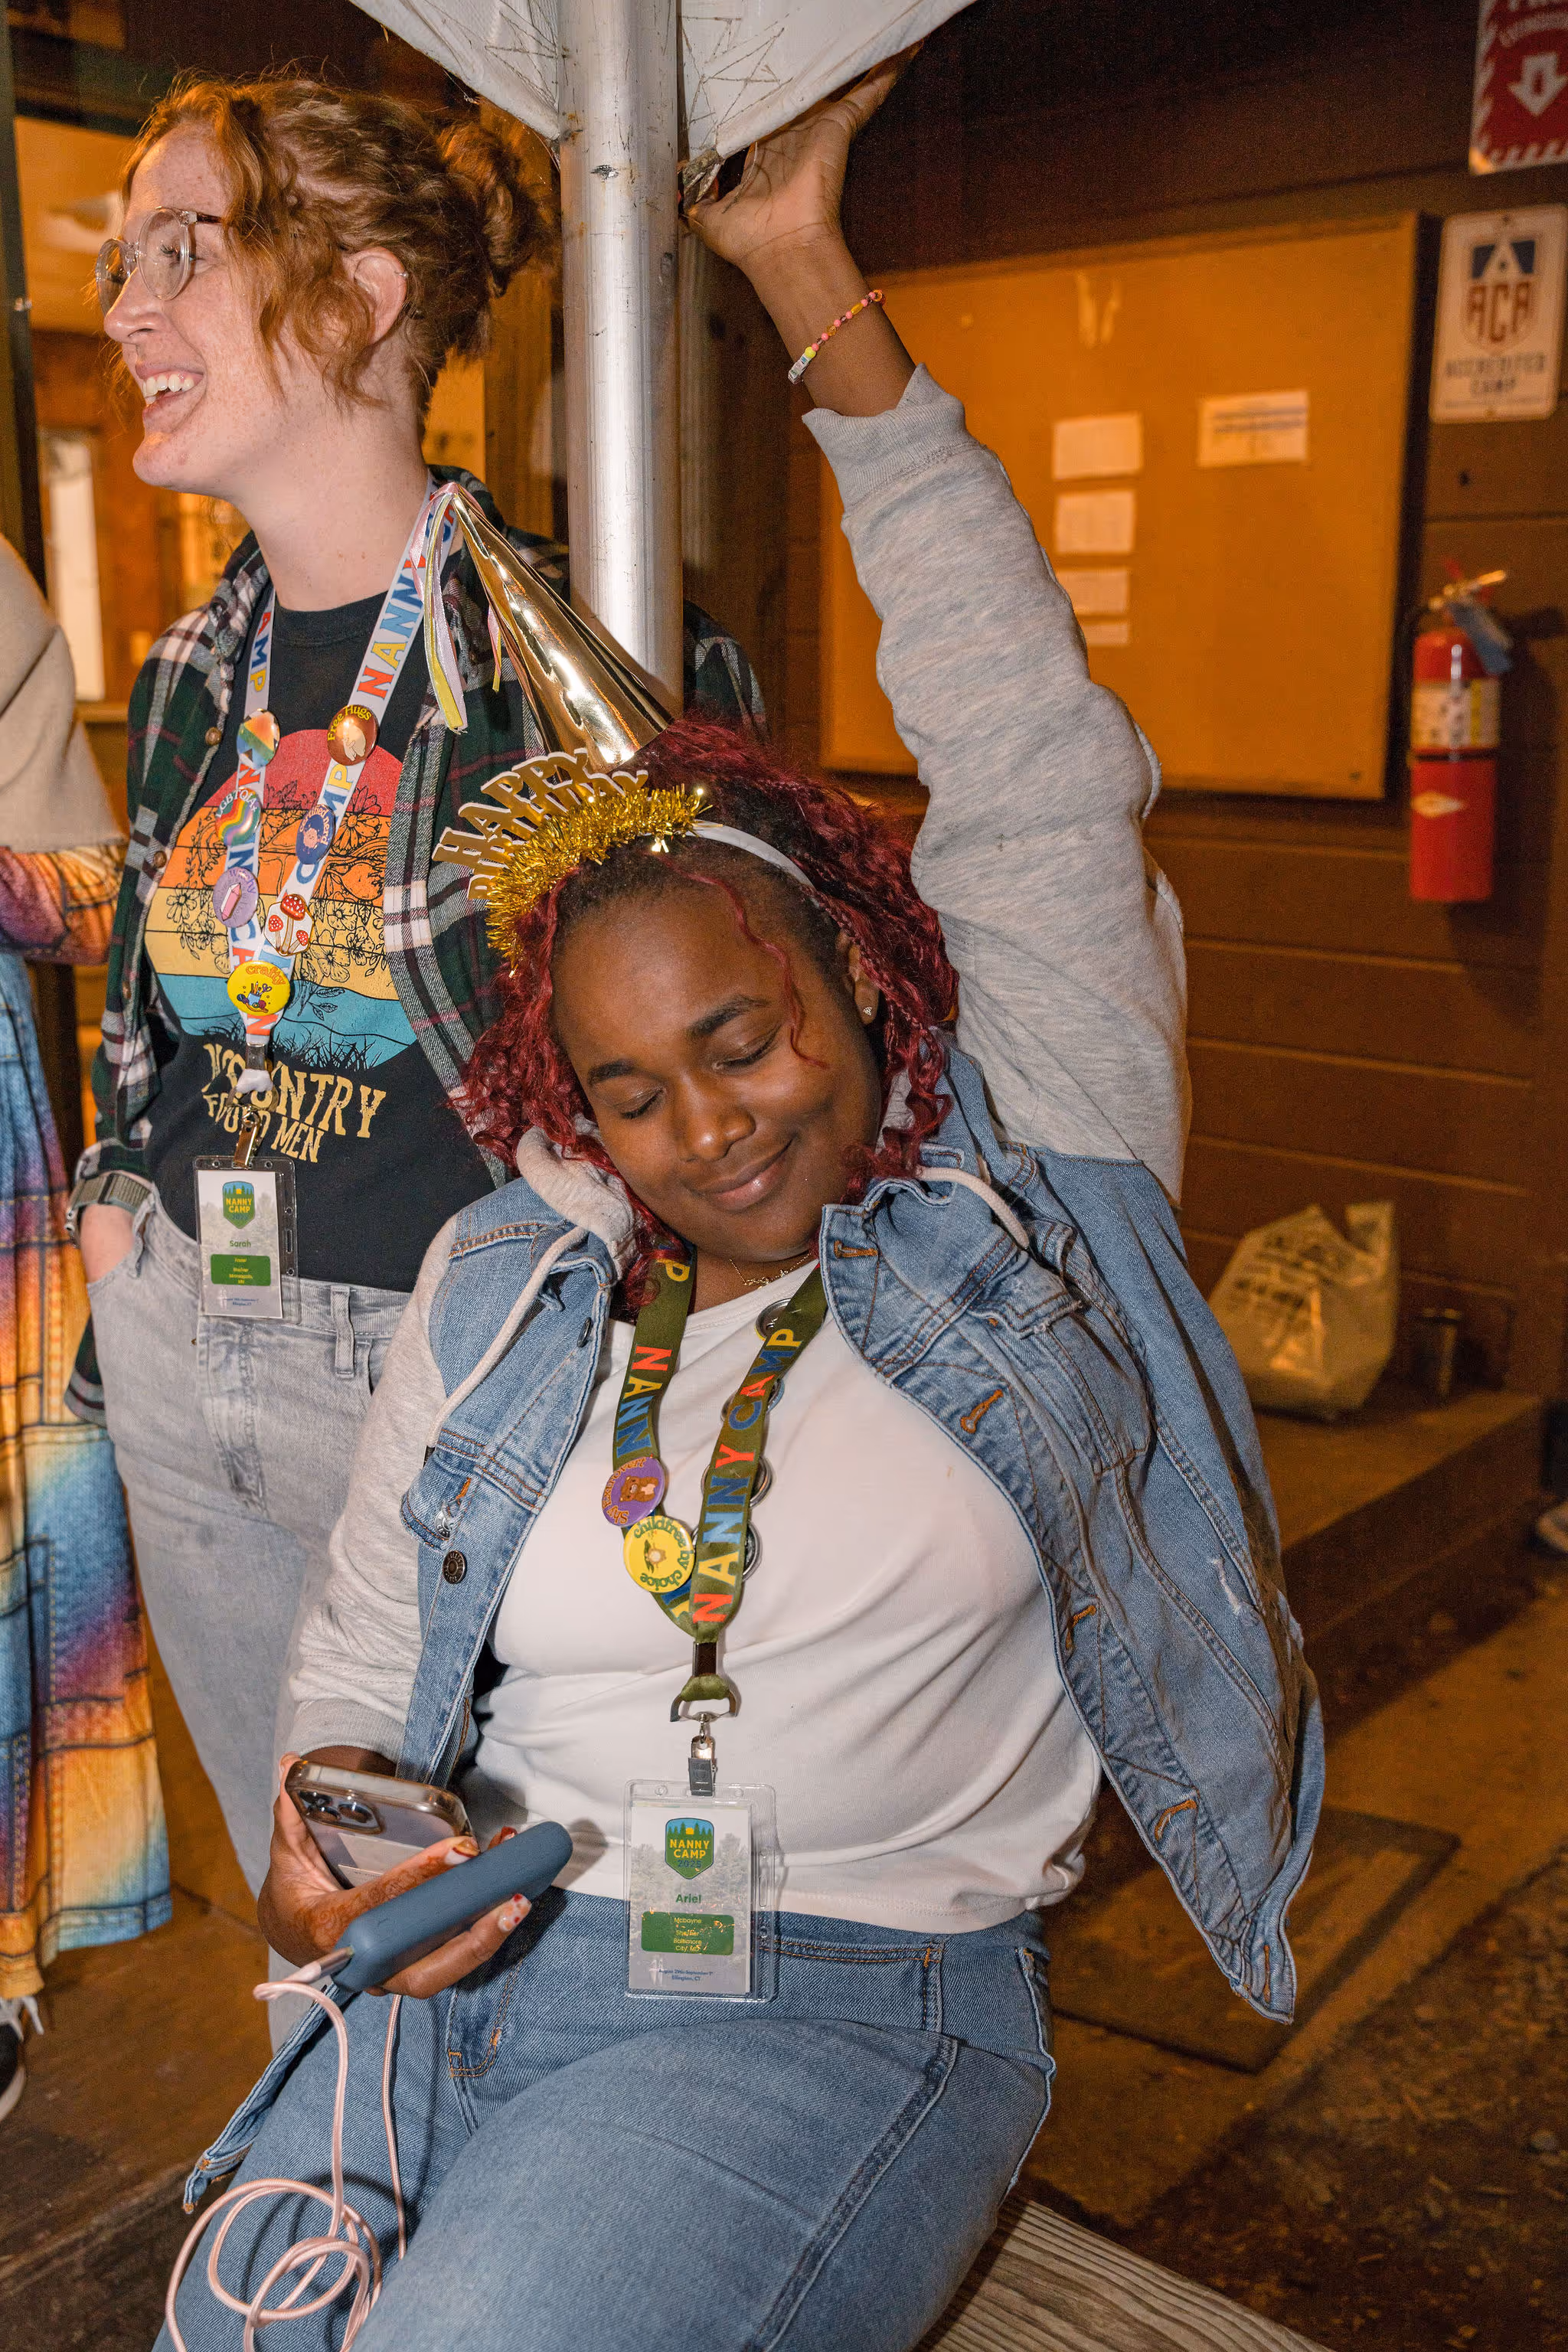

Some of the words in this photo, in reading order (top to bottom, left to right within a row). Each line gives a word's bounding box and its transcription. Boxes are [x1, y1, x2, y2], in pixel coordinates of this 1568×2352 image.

[327, 713, 345, 741] Free
[345, 704, 372, 720] Hugs
[320, 816, 330, 846] nerd
[245, 965, 286, 985] crafty
[270, 1116, 325, 1163] MEN
[226, 1197, 252, 1206] NANNY
[228, 1205, 251, 1214] CAMP
[229, 1240, 252, 1248] Sarah
[728, 1328, 802, 1430] CAMP
[607, 1504, 630, 1524] Shy
[633, 1516, 688, 1548] childfree
[692, 1443, 756, 1624] NANNY
[677, 1548, 694, 1570] by
[639, 1569, 683, 1591] choice
[669, 1839, 710, 1849] NANNY
[674, 1849, 706, 1859] CAMP
[678, 1860, 702, 1868] 2025
[676, 1893, 702, 1904] Ariel
